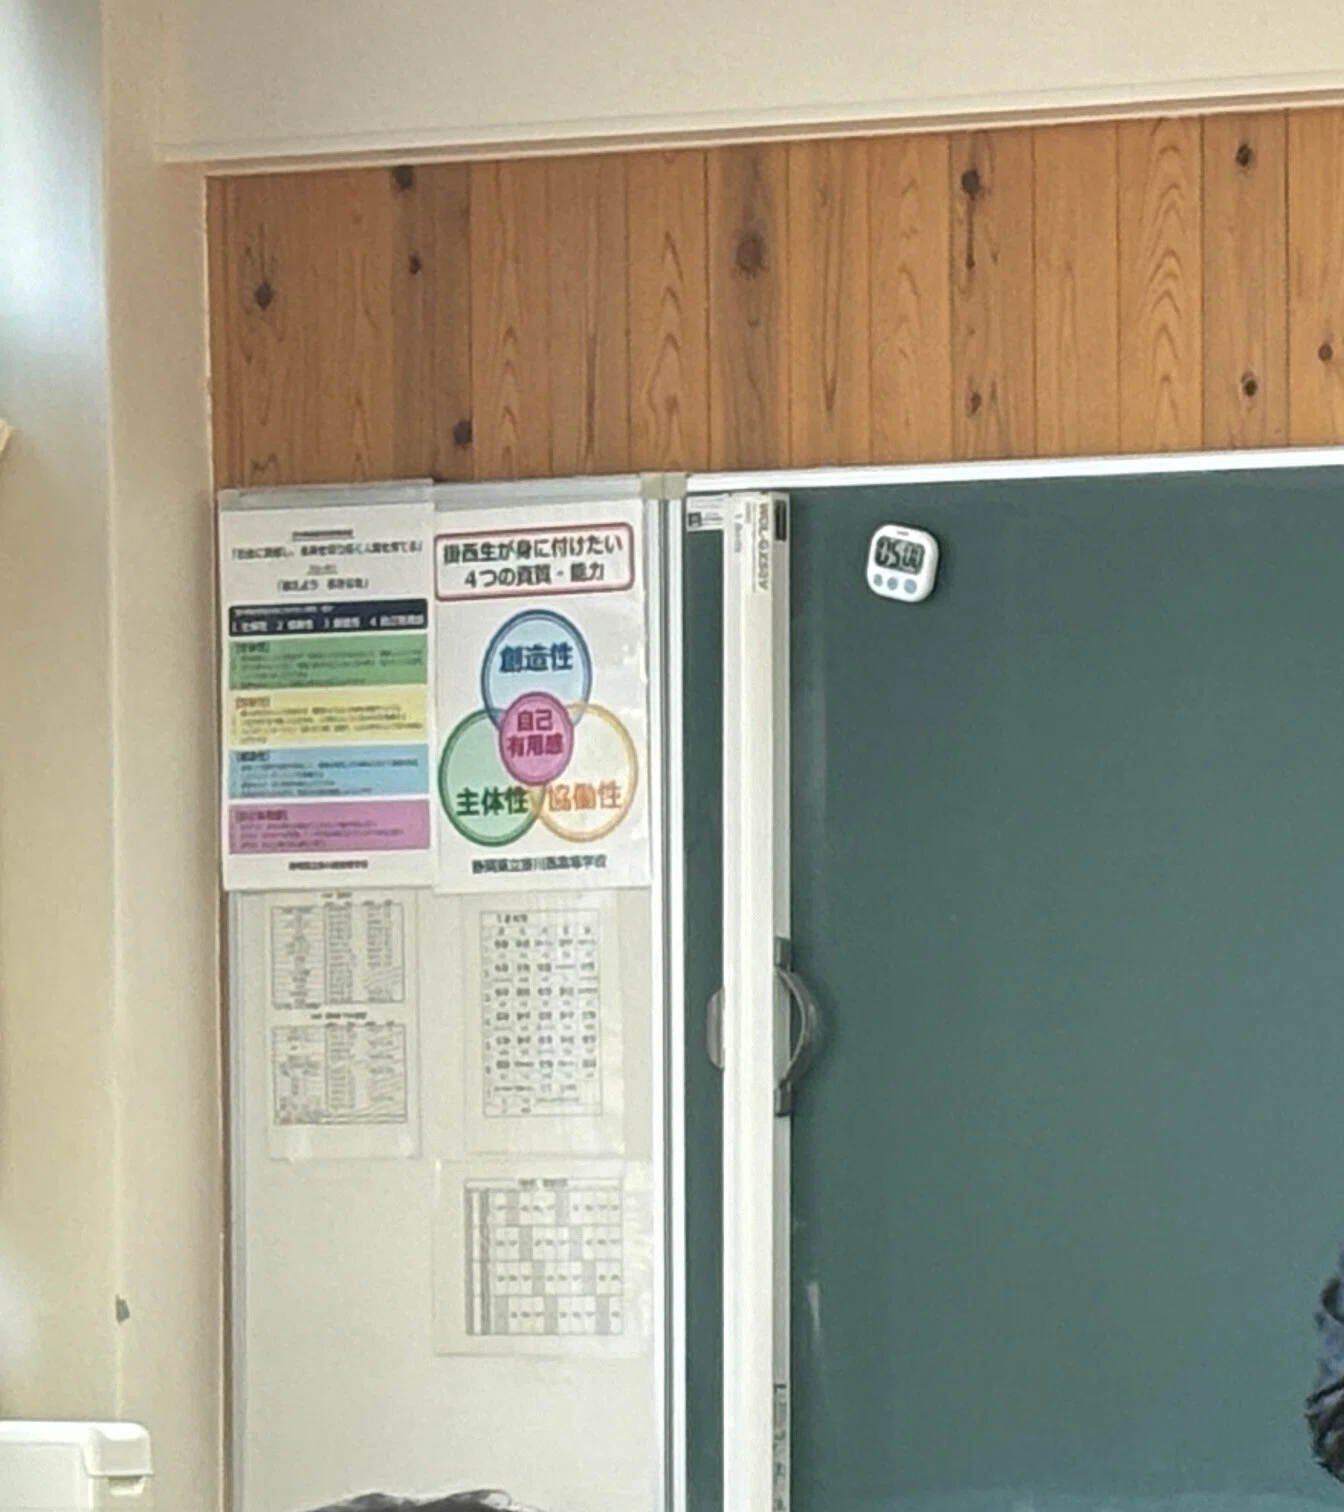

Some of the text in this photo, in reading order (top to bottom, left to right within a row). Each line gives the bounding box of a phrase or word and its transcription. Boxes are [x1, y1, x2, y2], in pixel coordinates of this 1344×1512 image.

[499, 640, 573, 673] 創造性
[517, 708, 554, 732] 自己
[506, 732, 564, 758] 有用感
[456, 785, 530, 817] 主体性
[548, 779, 622, 812] 協働性
